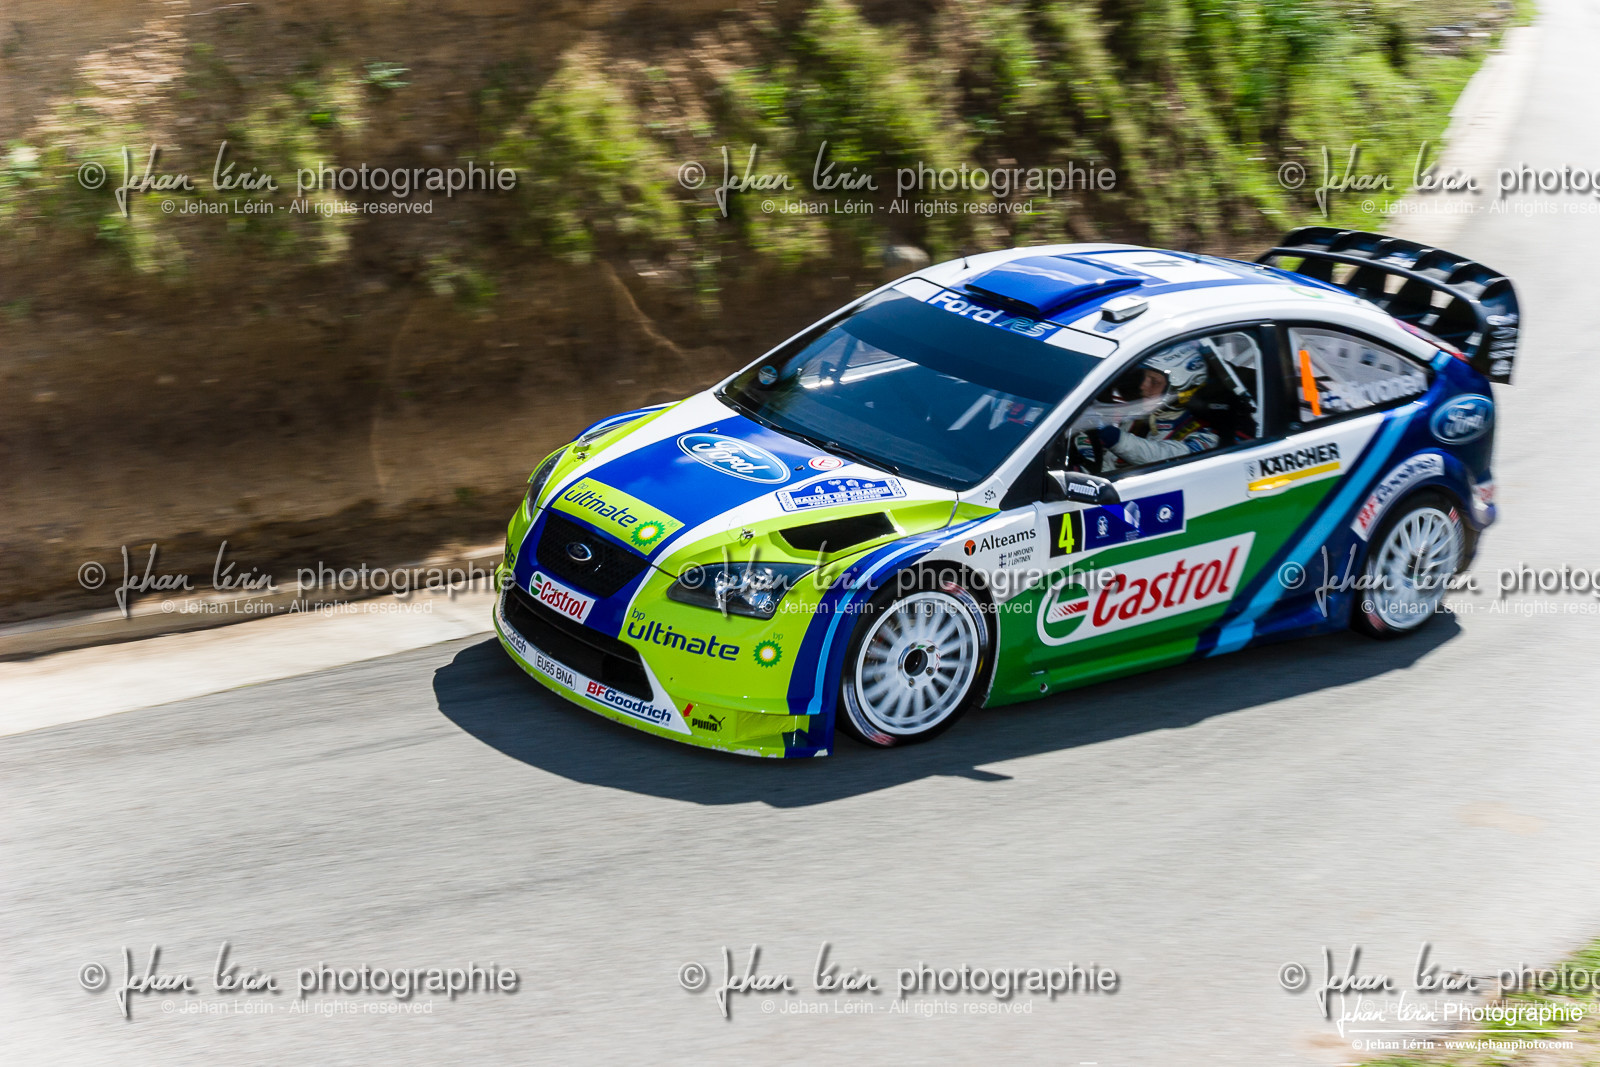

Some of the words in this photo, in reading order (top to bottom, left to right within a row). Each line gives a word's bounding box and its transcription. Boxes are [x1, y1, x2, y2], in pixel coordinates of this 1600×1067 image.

[928, 291, 1004, 326] Ford
[1002, 317, 1055, 338] RS
[692, 439, 771, 475] Ford
[815, 486, 824, 494] 4
[1068, 482, 1096, 496] PUMA
[564, 488, 638, 528] ultimate
[980, 528, 1036, 553] Alteams
[1058, 513, 1074, 554] 4
[541, 581, 587, 619] Castrol
[1092, 545, 1240, 627] Castrol
[631, 607, 645, 621] bp
[627, 619, 741, 662] ultimate
[537, 656, 556, 676] EU55
[556, 667, 574, 687] BNA
[587, 680, 671, 722] BFGoodrich
[692, 717, 718, 732] PUMA
